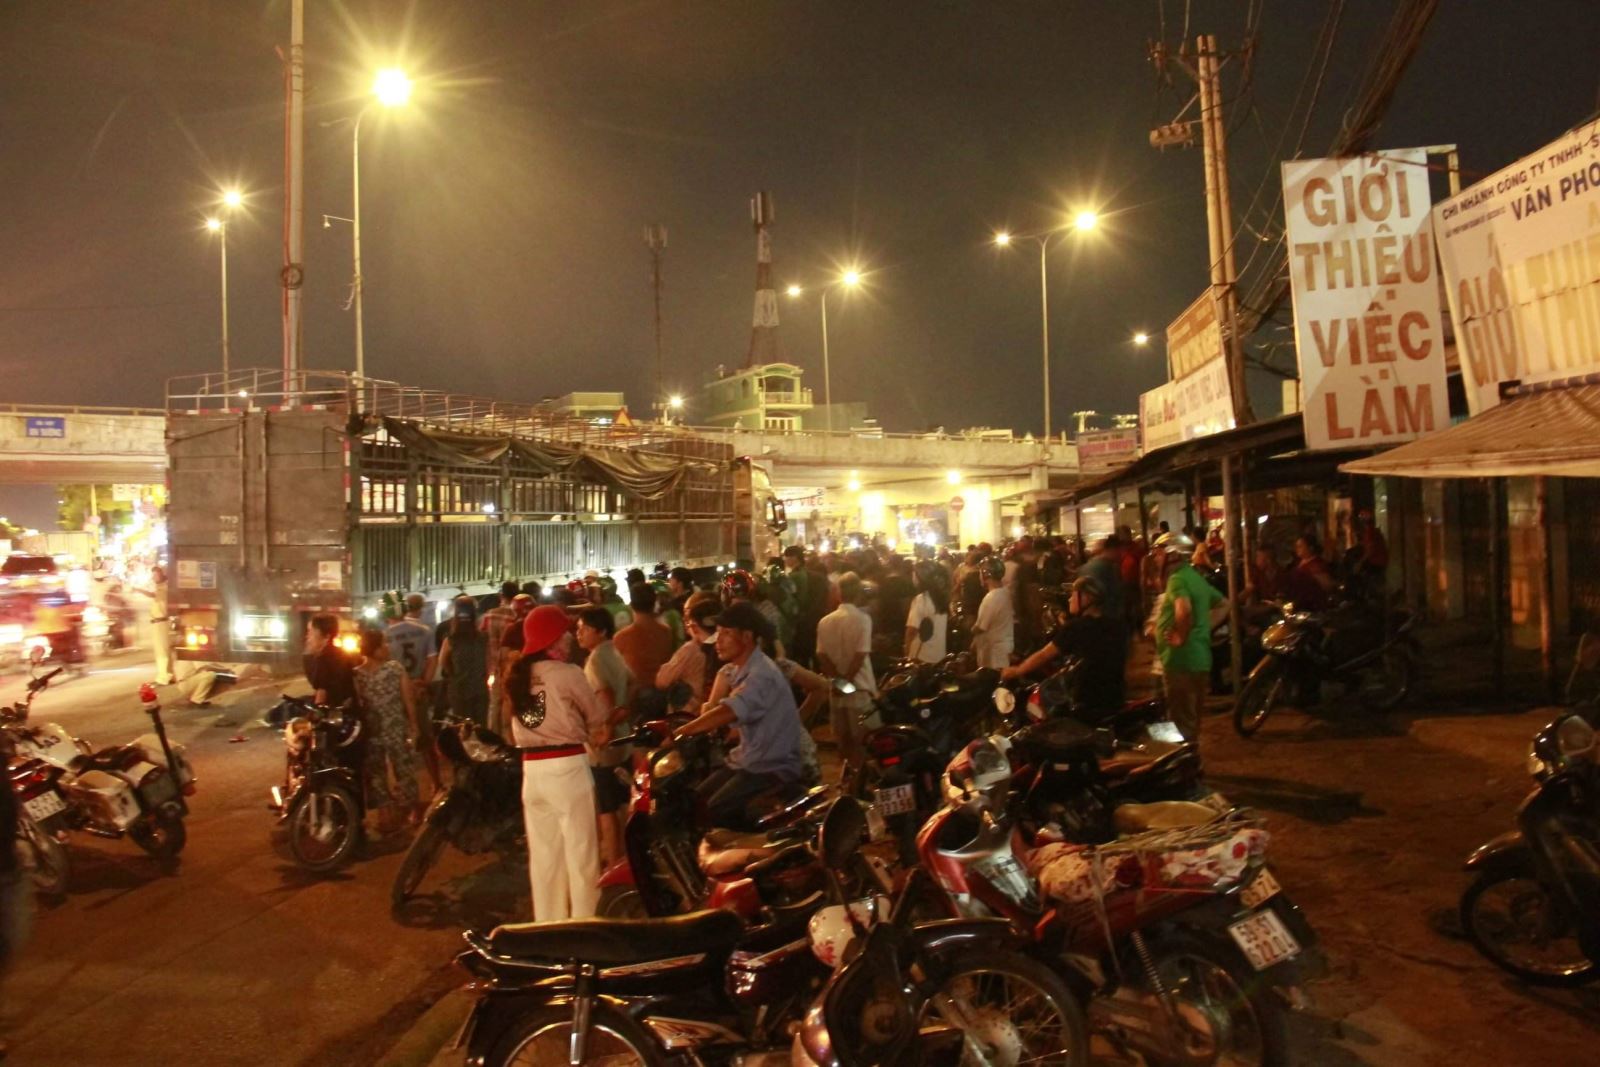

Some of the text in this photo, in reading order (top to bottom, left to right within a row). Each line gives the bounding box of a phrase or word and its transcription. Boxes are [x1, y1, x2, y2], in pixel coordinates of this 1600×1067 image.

[1303, 155, 1410, 227] GIỚI
[1530, 160, 1545, 178] TY
[1548, 142, 1583, 168] TNHH
[1510, 185, 1552, 221] VĂN
[1295, 223, 1431, 299] THIỆU
[1309, 301, 1432, 380] VIỆC
[1325, 375, 1434, 441] LÀM
